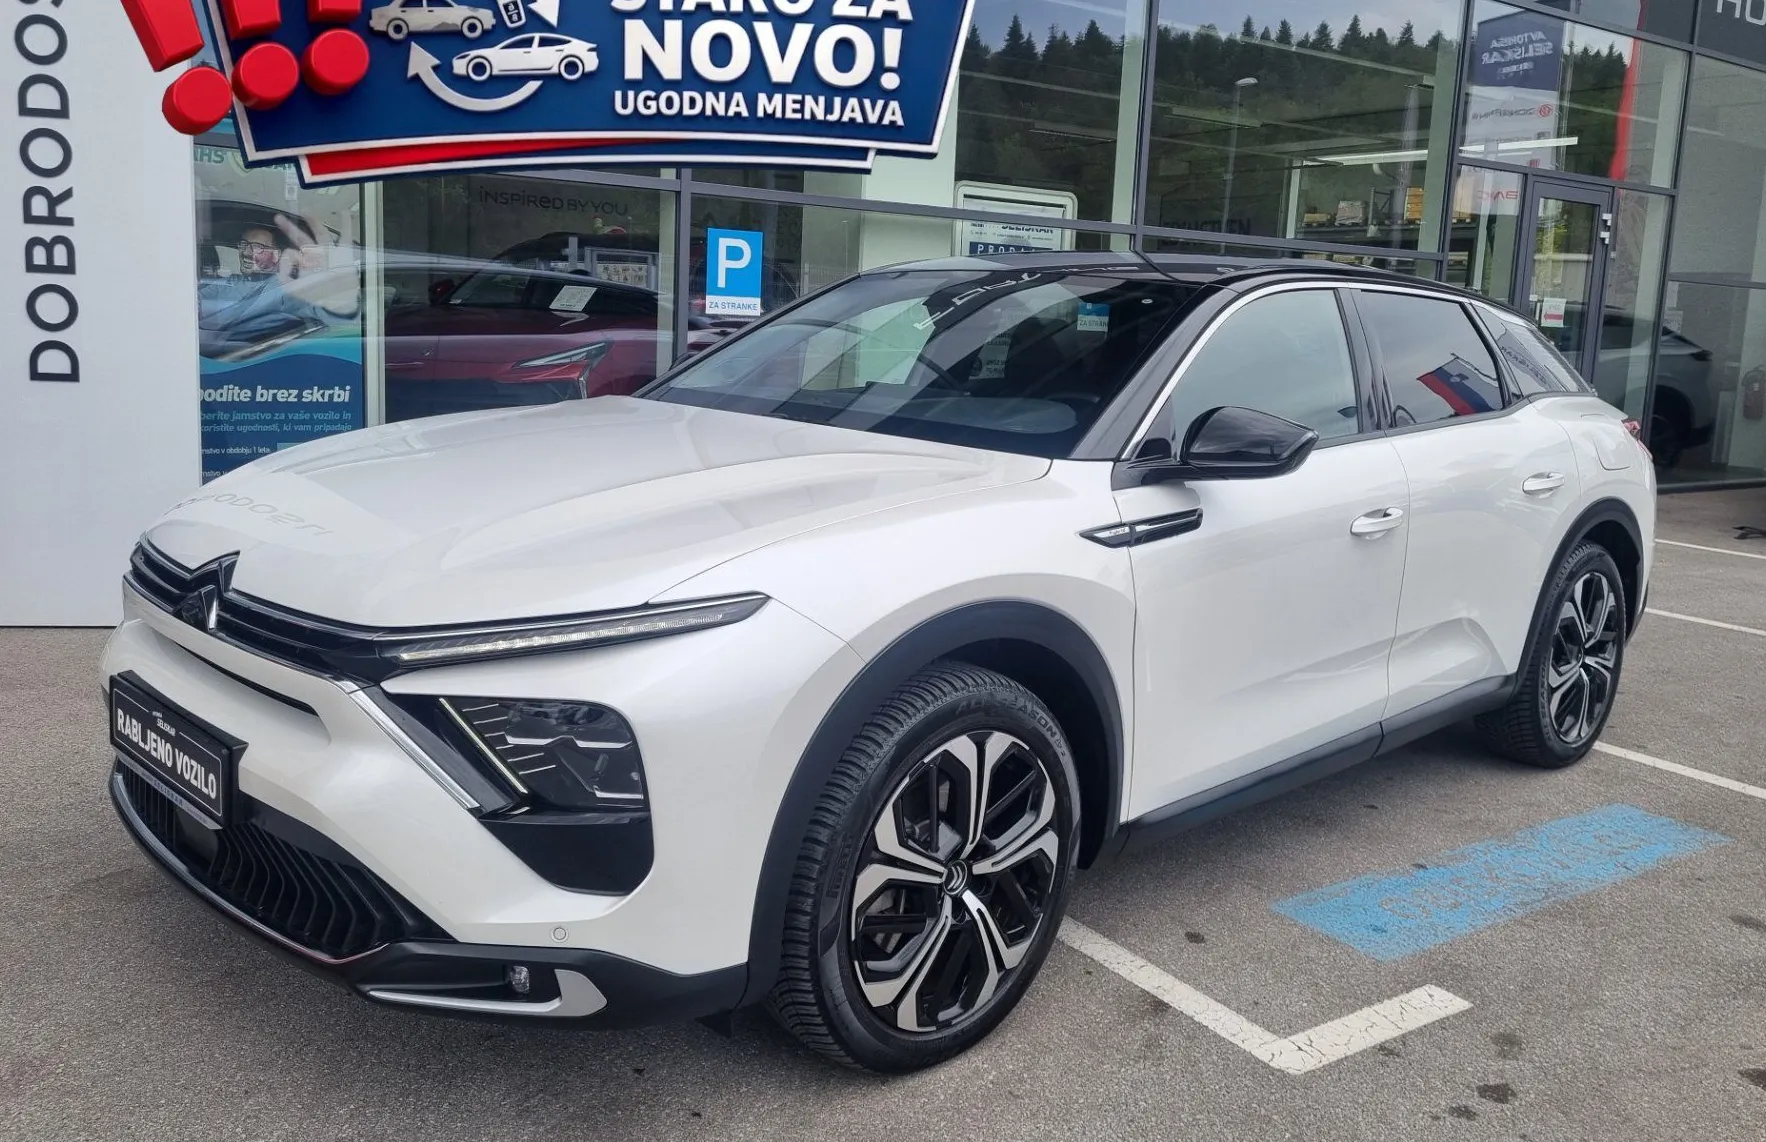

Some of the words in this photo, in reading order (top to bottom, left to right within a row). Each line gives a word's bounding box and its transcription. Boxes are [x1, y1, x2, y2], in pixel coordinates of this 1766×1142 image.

[14, 0, 80, 382] DOBRODO
[590, 200, 629, 216] YOU
[717, 237, 752, 288] P
[708, 301, 719, 309] ZA
[721, 302, 758, 311] STRANKE
[256, 385, 299, 402] brez
[302, 385, 351, 402] skrbi
[232, 411, 271, 422] jamstvo
[274, 412, 285, 420] za
[313, 411, 341, 420] vozilo
[343, 411, 352, 420] in
[283, 423, 292, 431] ki
[314, 423, 352, 433] pripadajo
[117, 707, 173, 768] RABLJENO
[175, 747, 217, 799] VOZILO
